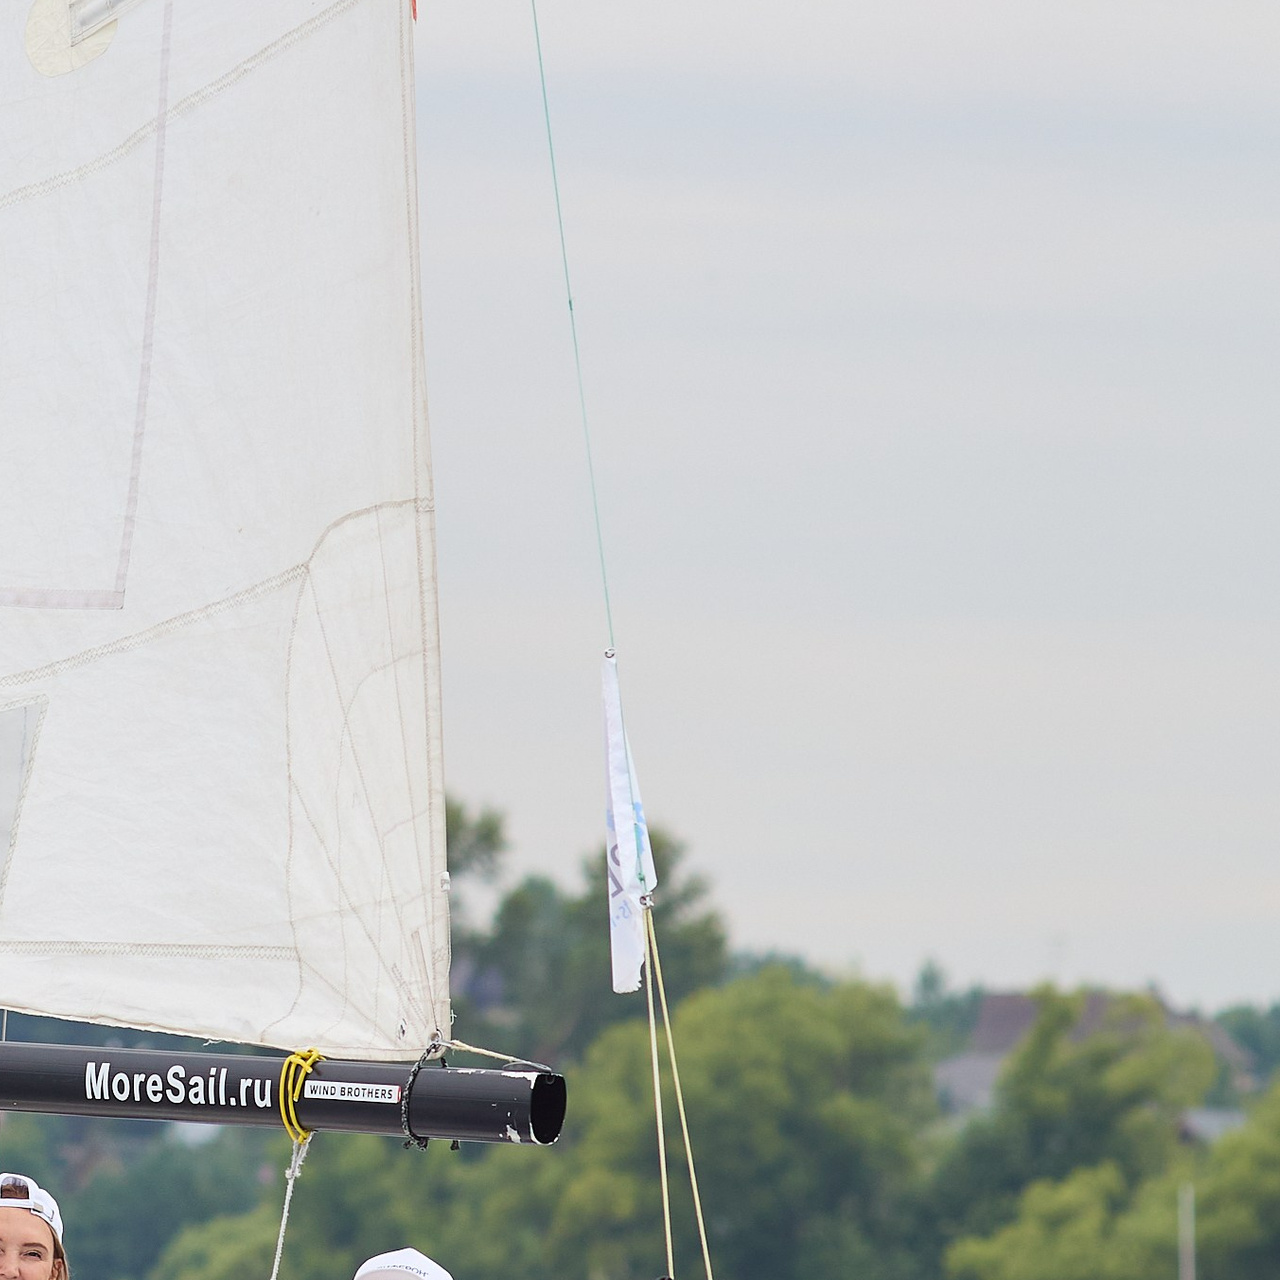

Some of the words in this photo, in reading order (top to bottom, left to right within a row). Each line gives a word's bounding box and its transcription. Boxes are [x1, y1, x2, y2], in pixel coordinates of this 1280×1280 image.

[85, 1061, 272, 1108] MoreSail.ru
[309, 1084, 337, 1096] WIND
[339, 1086, 393, 1100] BROTHERS
